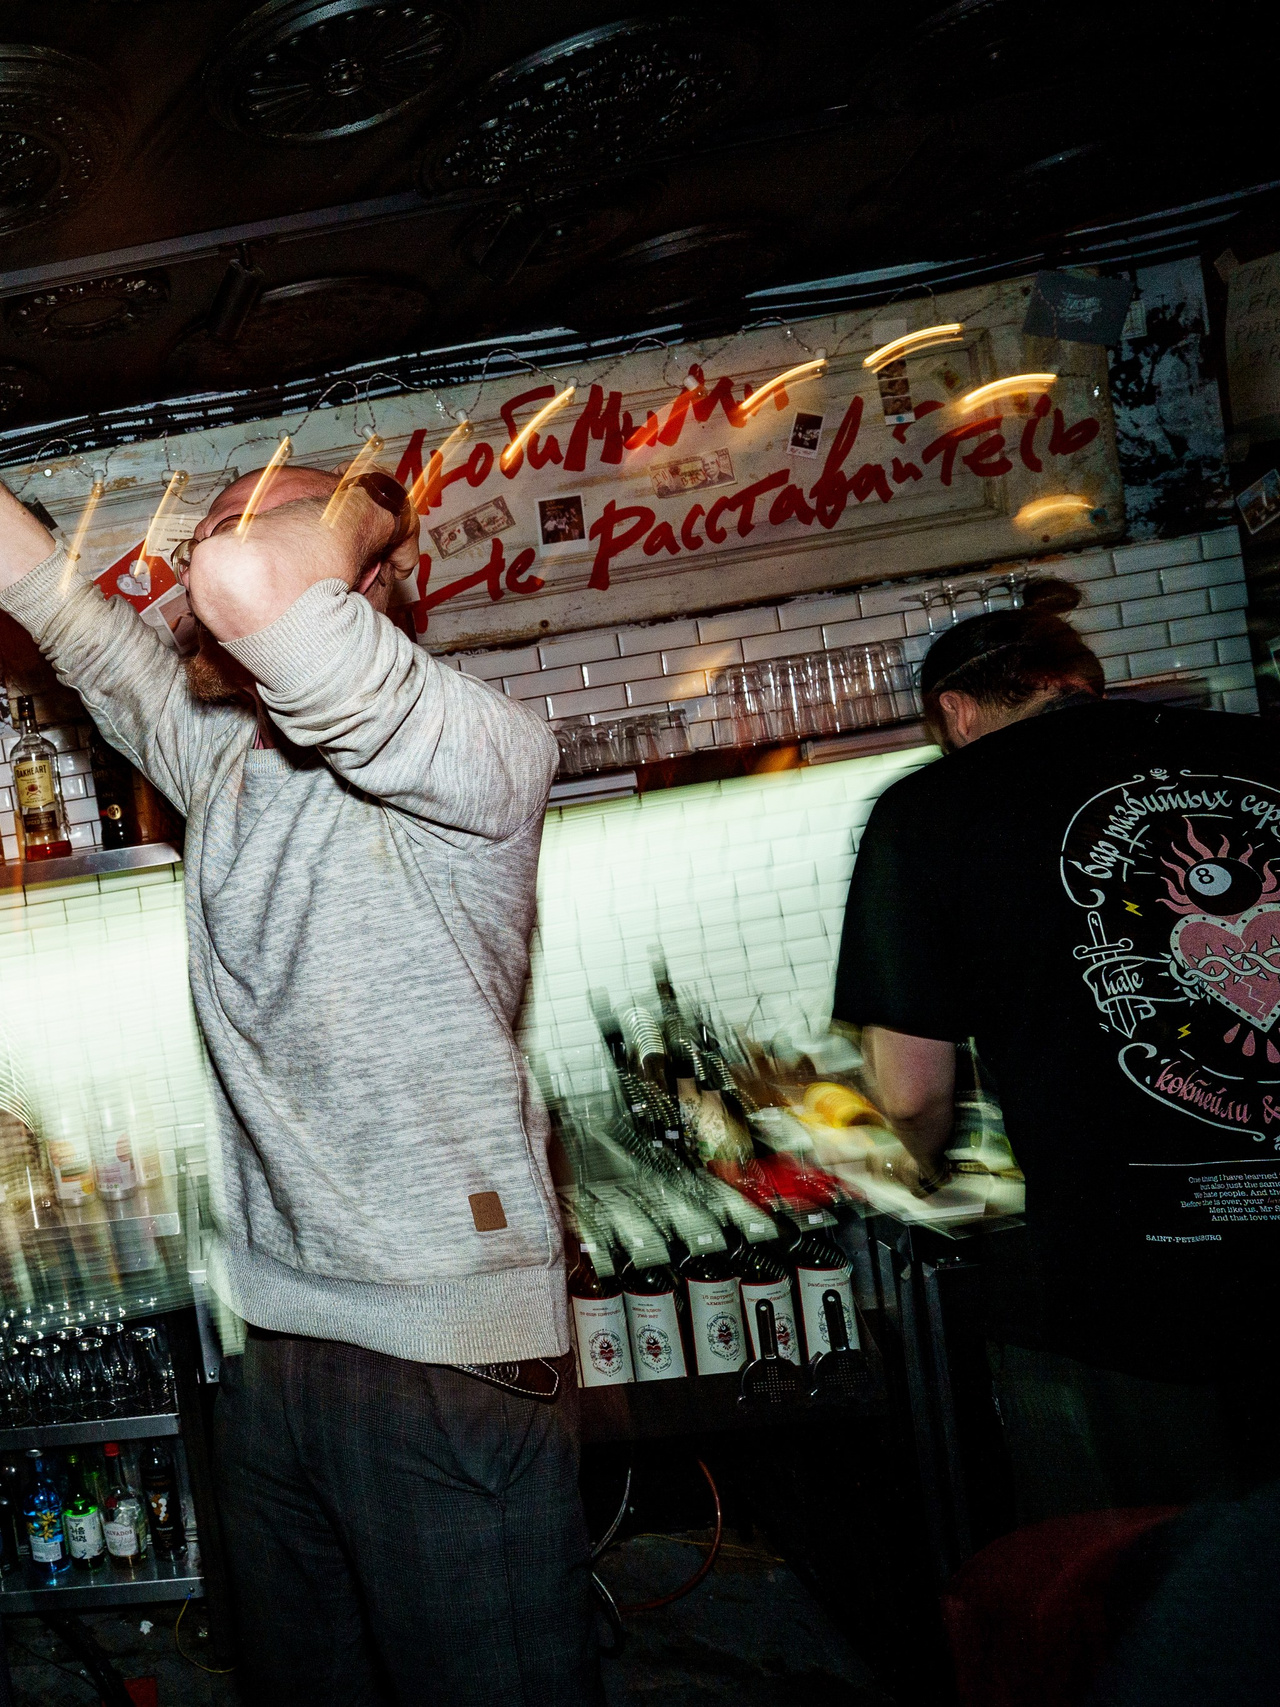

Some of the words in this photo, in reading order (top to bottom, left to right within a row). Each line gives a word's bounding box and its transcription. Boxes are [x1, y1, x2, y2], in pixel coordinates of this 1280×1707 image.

[16, 764, 47, 779] OAKHEART
[1195, 867, 1215, 885] 8
[1101, 960, 1147, 997] hate
[1154, 1061, 1252, 1124] коктейли
[1222, 1173, 1244, 1181] have
[1244, 1172, 1278, 1180] learned
[1210, 1182, 1225, 1190] also
[1225, 1182, 1243, 1190] just
[1243, 1181, 1258, 1189] the
[1219, 1190, 1249, 1198] people.
[1250, 1189, 1268, 1197] And
[1243, 1198, 1265, 1206] your
[1209, 1206, 1227, 1214] Men
